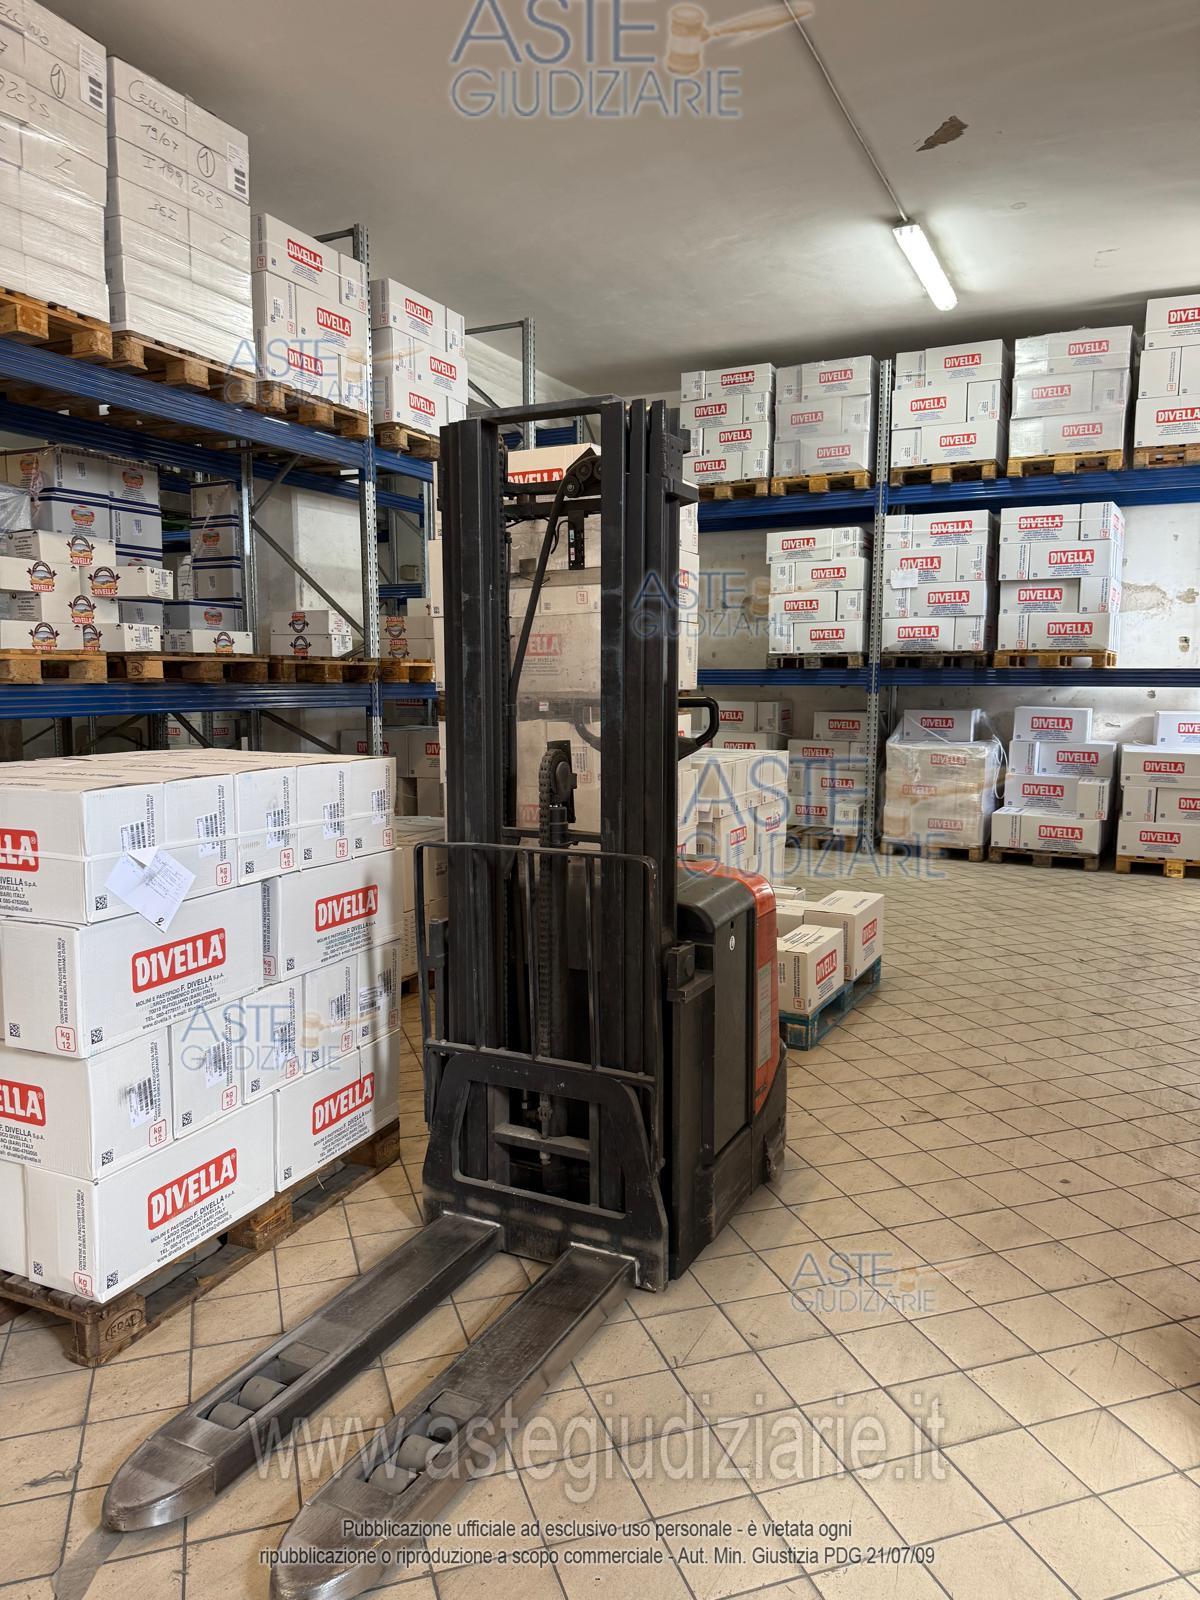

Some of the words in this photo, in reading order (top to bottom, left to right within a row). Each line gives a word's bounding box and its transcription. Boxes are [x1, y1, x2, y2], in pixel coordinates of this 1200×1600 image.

[289, 242, 321, 268] DIVELLA
[405, 300, 432, 323] DIVELLA
[318, 309, 350, 334] DIVELLA
[1070, 341, 1108, 354] DIVELLA
[288, 351, 322, 374] DIVELLA
[945, 355, 980, 367] DIVELLA
[431, 358, 456, 378] DIVELLA
[722, 372, 753, 385] DIVELLA
[821, 370, 851, 382] DIVELLA
[1034, 386, 1069, 398] DIVELLA
[410, 394, 434, 415] DIVELLA
[697, 405, 726, 416] DIVELLA
[911, 398, 945, 411] DIVELLA
[793, 413, 821, 424] DIVELLA
[721, 430, 751, 442] DIVELLA
[1064, 424, 1101, 437] DIVELLA
[941, 435, 975, 446] DIVELLA
[819, 447, 849, 457] DIVELLA
[695, 461, 725, 471] DIVELLA
[932, 521, 971, 534] DIVELLA
[1020, 516, 1062, 528] DIVELLA
[783, 539, 814, 549] DIVELLA
[1050, 550, 1093, 563] DIVELLA
[902, 557, 940, 570] DIVELLA
[813, 568, 845, 578] DIVELLA
[33, 584, 53, 592] DIVELLA
[929, 592, 969, 603] DIVELLA
[1019, 589, 1061, 603] DIVELLA
[785, 601, 818, 610] DIVELLA
[811, 629, 843, 640] DIVELLA
[899, 627, 938, 638] DIVELLA
[1049, 623, 1092, 634] DIVELLA
[830, 720, 860, 730] DIVELLA
[922, 718, 952, 728] DIVELLA
[1033, 718, 1071, 729] DIVELLA
[803, 748, 833, 757] DIVELLA
[1058, 752, 1098, 765] DIVELLA
[1144, 762, 1183, 773] DIVELLA
[822, 779, 853, 788] DIVELLA
[1023, 785, 1063, 797] DIVELLA
[796, 806, 827, 816] DIVELLA
[928, 819, 961, 830] DIVELLA
[1040, 826, 1083, 841] DIVELLA
[1140, 831, 1182, 844] DIVELLA
[338, 842, 346, 850] kg
[283, 852, 291, 860] kg
[220, 875, 227, 883] 12
[317, 889, 376, 927] DIVELLA
[135, 934, 223, 987] DIVELLA
[818, 952, 837, 984] DIVELLA
[135, 997, 152, 1007] MOLINI
[155, 987, 180, 1000] PASTIFICIO
[180, 983, 186, 991] F.
[186, 974, 212, 989] DIVELLA
[166, 989, 190, 1002] DOMENICO
[190, 982, 209, 993] DIVELLA,
[162, 996, 188, 1009] RUTIGLIANO
[202, 986, 214, 995] ITALY
[60, 1030, 71, 1040] kg
[62, 1041, 71, 1050] 12
[315, 1079, 372, 1130] DIVELLA
[5, 1125, 32, 1138] DIVELLA
[153, 1126, 162, 1135] kg
[154, 1134, 162, 1142] 12
[152, 1156, 235, 1223] DIVELLA
[170, 1214, 193, 1232] PASTIFICIO
[193, 1210, 198, 1218] F.
[199, 1193, 224, 1214] DIVELLA
[180, 1214, 202, 1231] DOMENICO
[175, 1221, 201, 1240] RUTIGLIANO
[78, 1276, 88, 1287] kg
